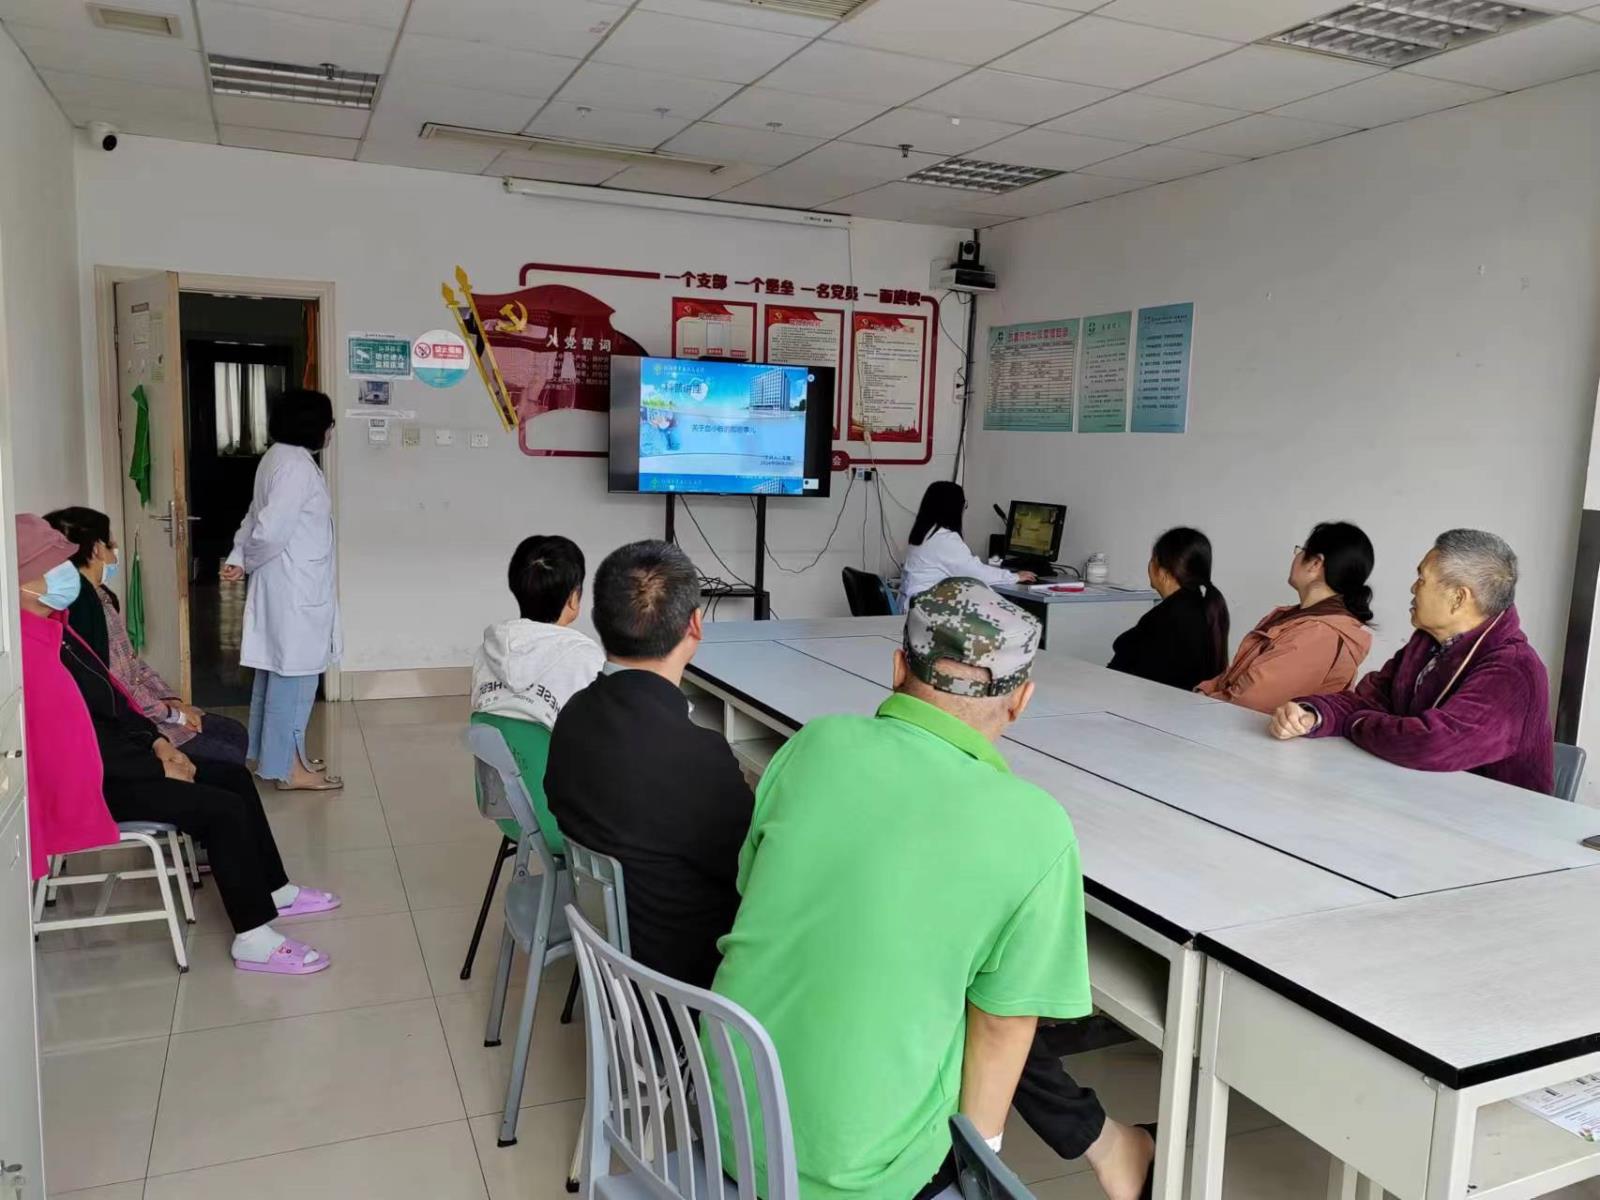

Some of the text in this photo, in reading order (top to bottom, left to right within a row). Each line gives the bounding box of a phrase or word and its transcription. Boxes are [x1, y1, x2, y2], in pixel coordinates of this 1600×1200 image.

[664, 271, 727, 290] 一个支部
[735, 277, 794, 296] 一个堡垒
[800, 283, 859, 301] 一名党员
[546, 333, 612, 352] 入党誓词
